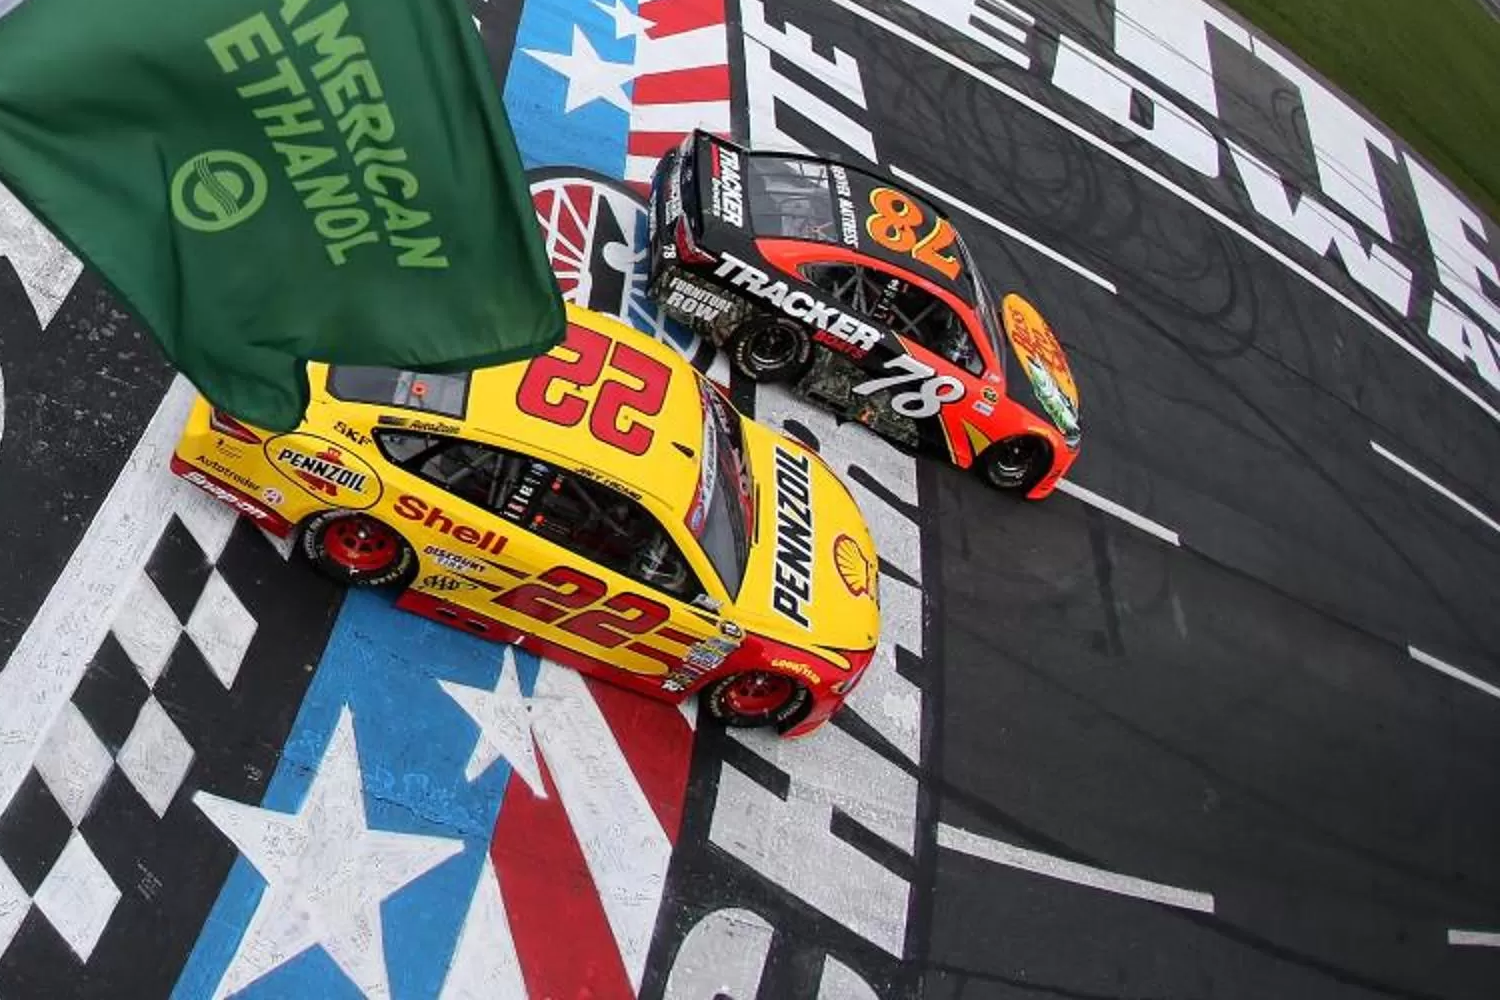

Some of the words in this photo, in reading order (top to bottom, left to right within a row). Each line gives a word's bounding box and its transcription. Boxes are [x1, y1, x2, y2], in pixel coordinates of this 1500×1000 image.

[204, 10, 379, 267] ETHANOL
[719, 146, 745, 228] TRACKER
[864, 185, 964, 281] 78
[665, 289, 719, 323] ROW
[713, 251, 882, 354] TRACKER
[516, 322, 673, 456] 22
[852, 353, 966, 419] 78
[195, 454, 262, 492] Autotrader
[277, 447, 367, 494] PENNZOIL
[332, 420, 373, 447] SKF
[393, 492, 509, 555] Shell
[773, 445, 815, 632] PENNZOIL
[493, 564, 671, 649] 22
